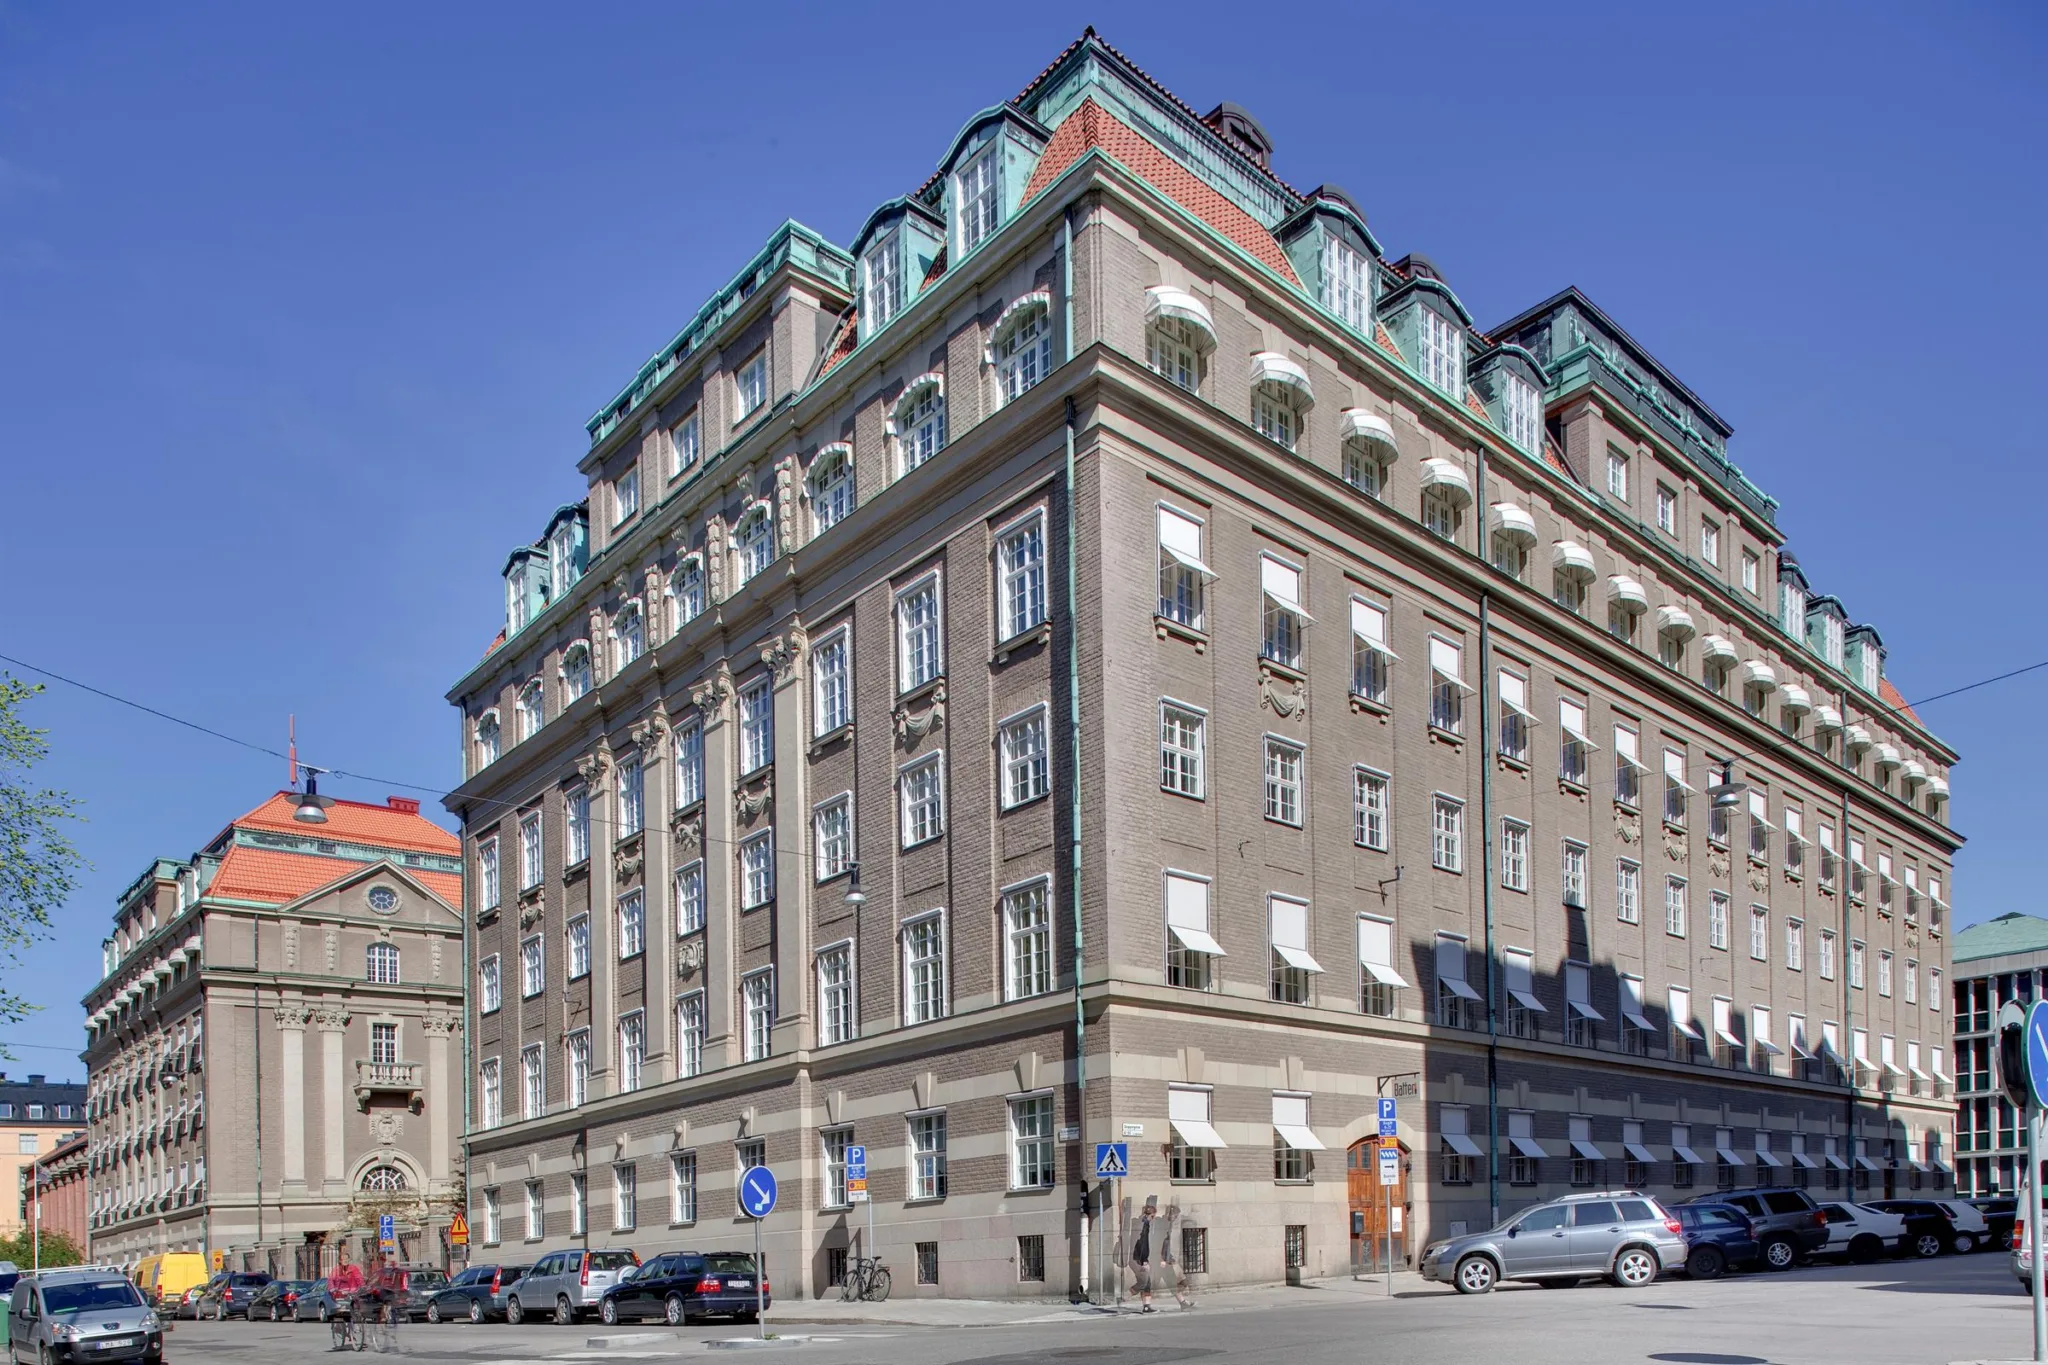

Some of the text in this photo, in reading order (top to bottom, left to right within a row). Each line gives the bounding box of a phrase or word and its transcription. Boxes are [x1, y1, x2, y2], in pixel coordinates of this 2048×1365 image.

[1384, 1101, 1392, 1117] P
[852, 1148, 861, 1163] P
[384, 1216, 391, 1225] P
